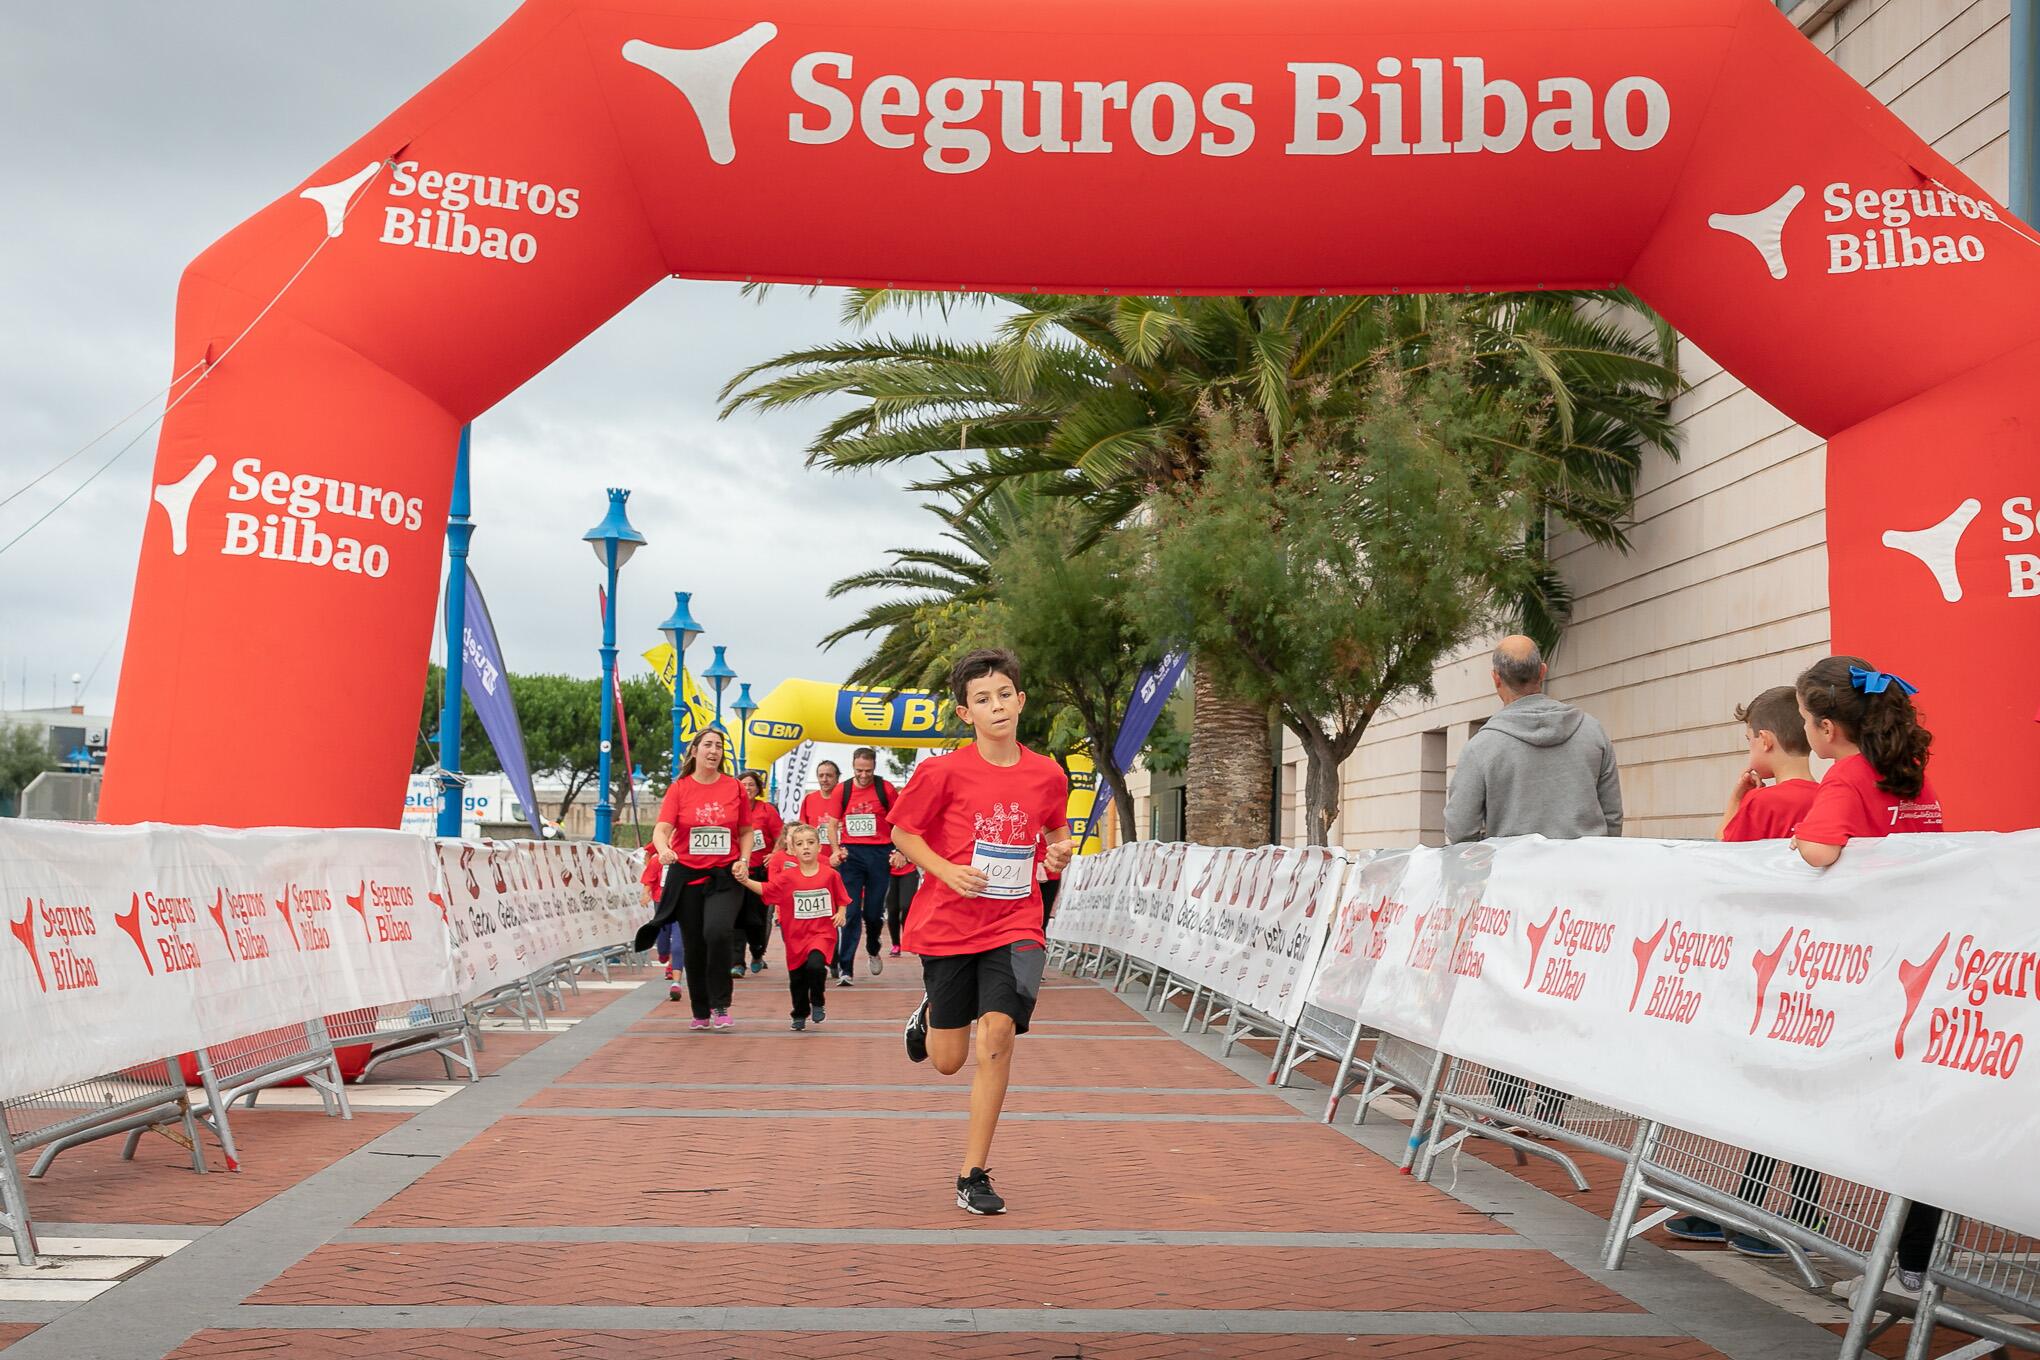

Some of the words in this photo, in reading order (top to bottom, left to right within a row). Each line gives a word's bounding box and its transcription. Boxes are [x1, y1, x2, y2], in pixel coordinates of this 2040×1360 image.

[788, 51, 1256, 174] Seguros
[1285, 57, 1671, 156] Bilbao
[388, 161, 581, 219] Seguros
[1823, 182, 2000, 226] Seguros
[379, 206, 538, 264] Bilbao
[1827, 228, 1986, 274] Bilbao
[228, 458, 424, 531] Seguros
[2001, 497, 2040, 542] S
[221, 513, 390, 577] Bilbao
[772, 724, 800, 738] BM
[694, 834, 725, 847] 2041
[849, 820, 873, 831] 2036
[983, 863, 1021, 880] 1021
[145, 891, 196, 931] Seguros
[225, 888, 266, 924] Seguros
[292, 883, 332, 918] Seguros
[370, 880, 413, 912] Seguros
[797, 897, 826, 912] 2041
[40, 898, 96, 945] Seguros
[235, 928, 269, 960] Bilbao
[1553, 908, 1616, 957] Seguros
[49, 948, 98, 990] Bilbao
[1663, 920, 1734, 974] Seguros
[1788, 928, 1873, 990] Seguros
[1537, 957, 1586, 1001] Bilbao
[1644, 975, 1702, 1024] Bilbao
[1767, 992, 1835, 1048] Bilbao
[1922, 1006, 2024, 1080] Bilbao
